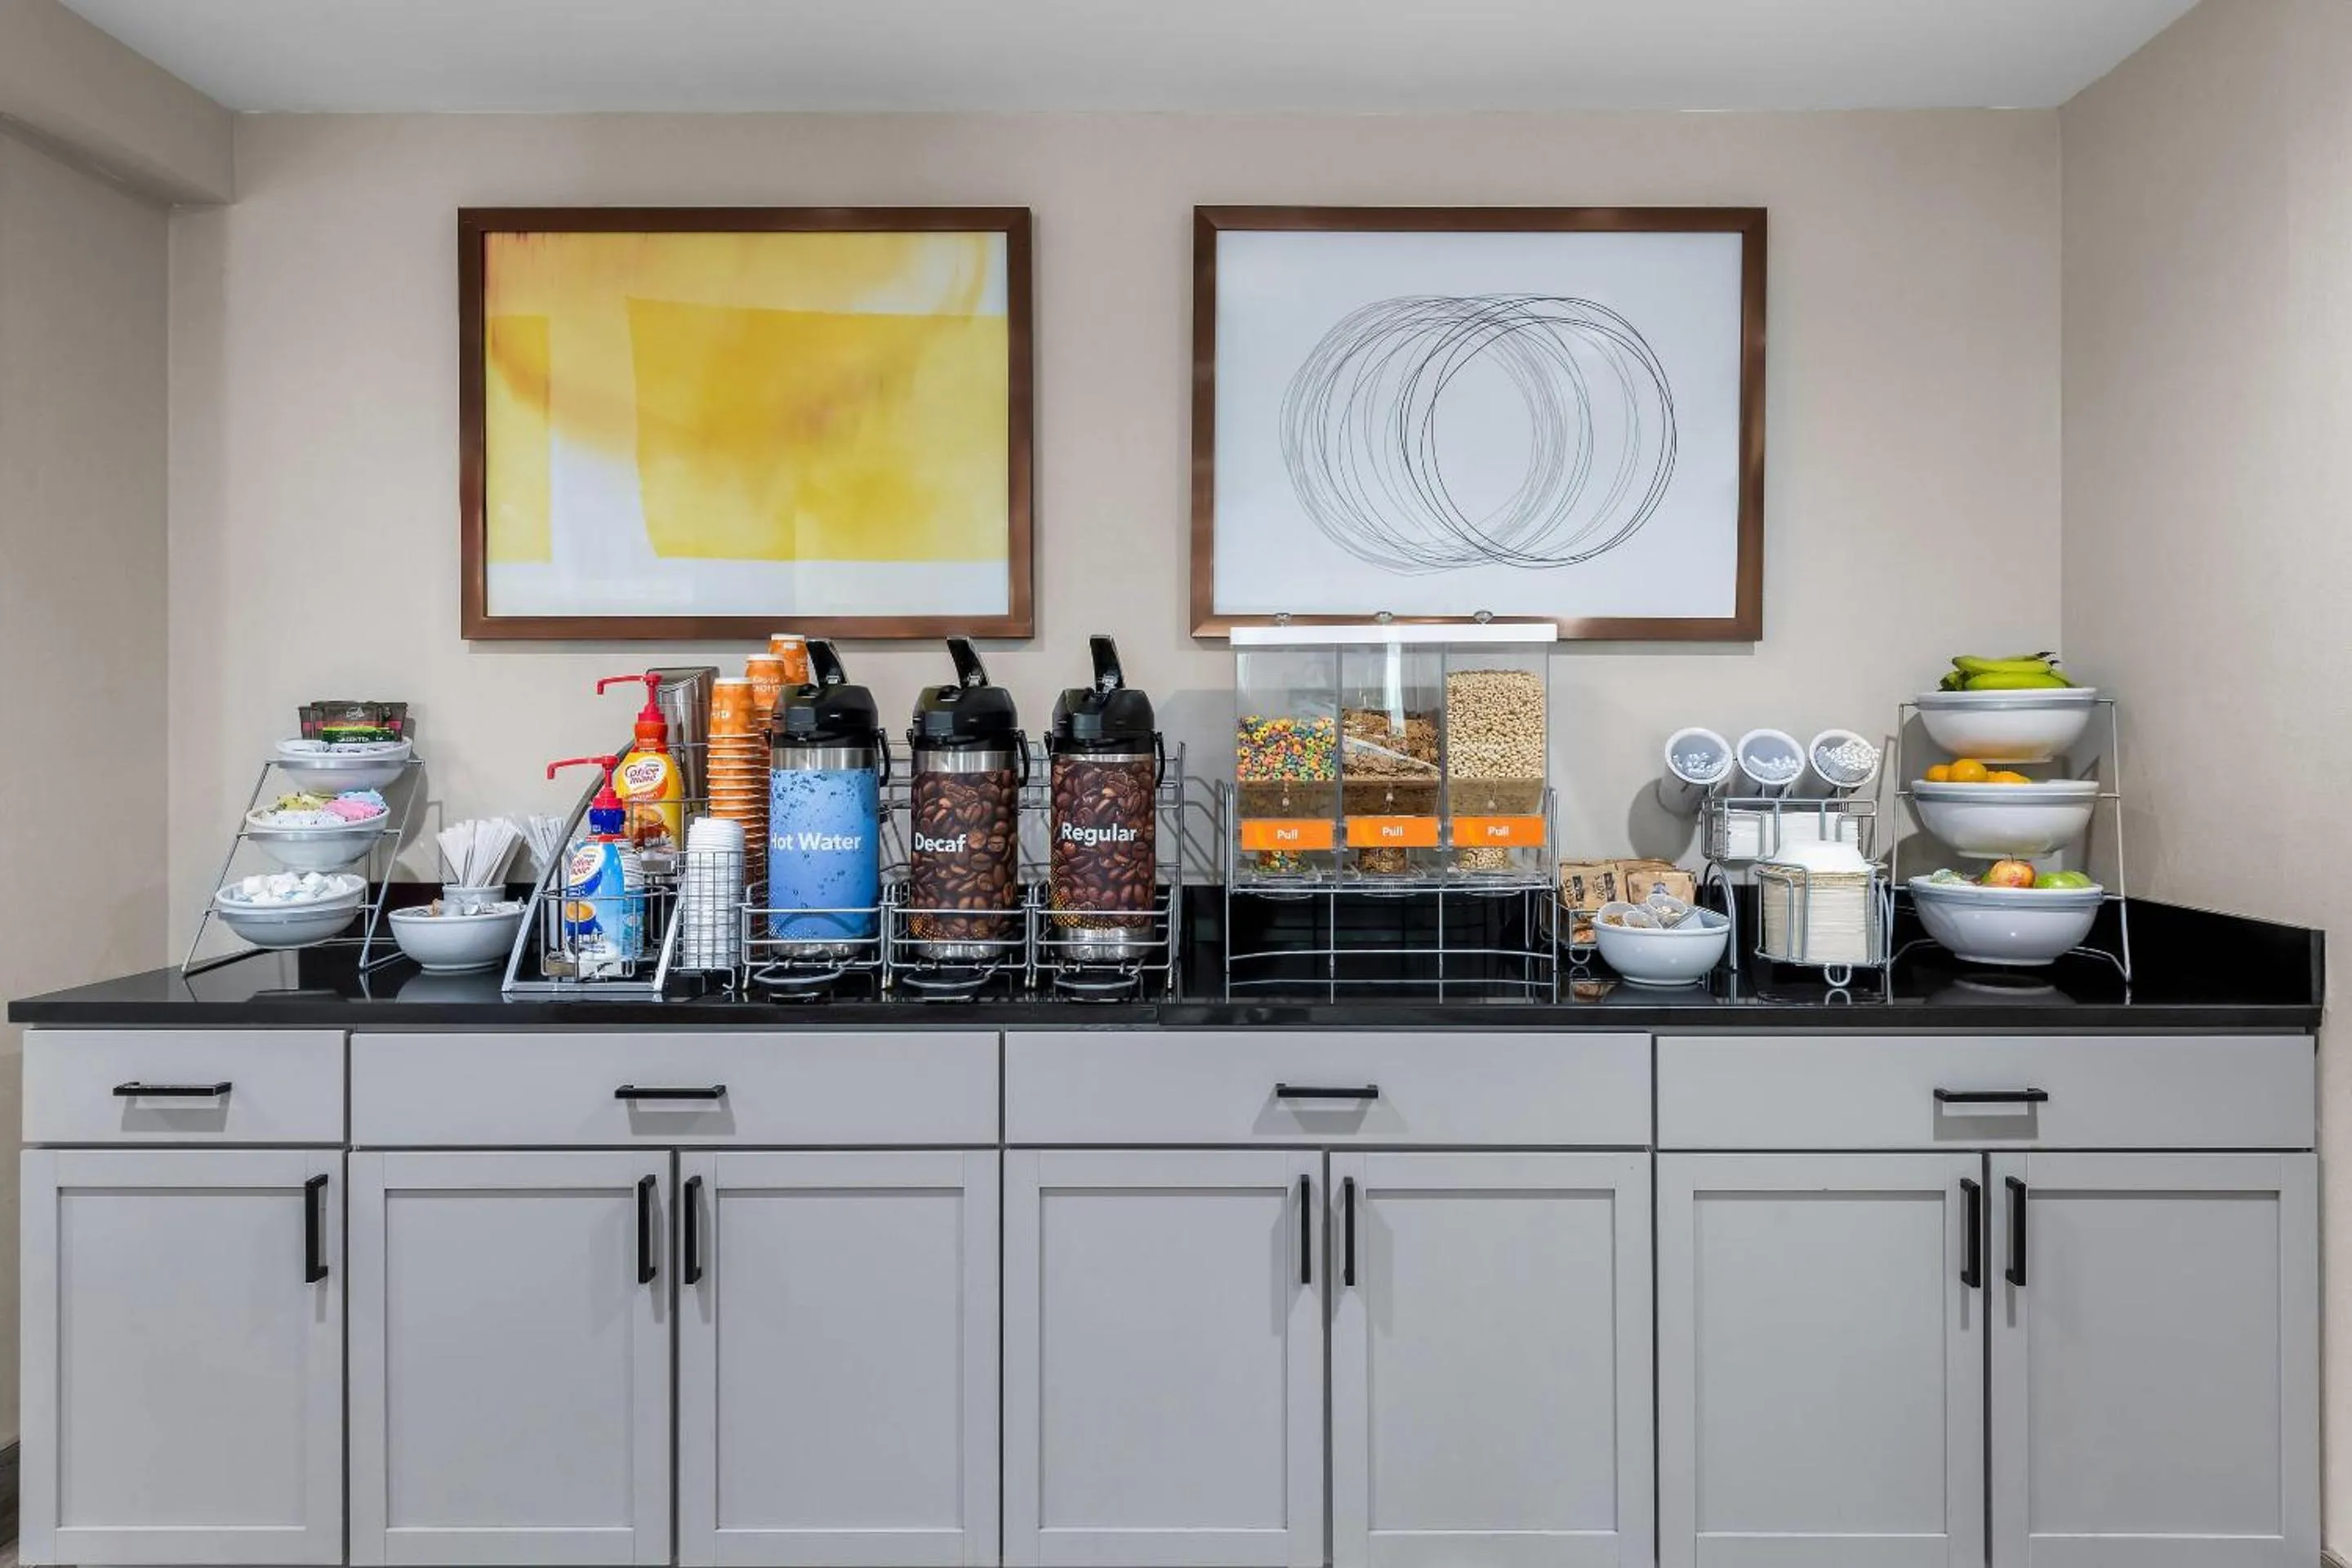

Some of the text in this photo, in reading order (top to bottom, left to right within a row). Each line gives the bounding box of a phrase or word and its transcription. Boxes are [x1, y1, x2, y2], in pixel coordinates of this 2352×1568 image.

[625, 764, 660, 777] Coffee
[1062, 822, 1138, 847] Regular
[1276, 828, 1298, 840] Pull
[1382, 825, 1403, 837] Pull
[1487, 825, 1509, 837] Pull
[797, 831, 862, 851] Water
[915, 832, 967, 852] Decaf
